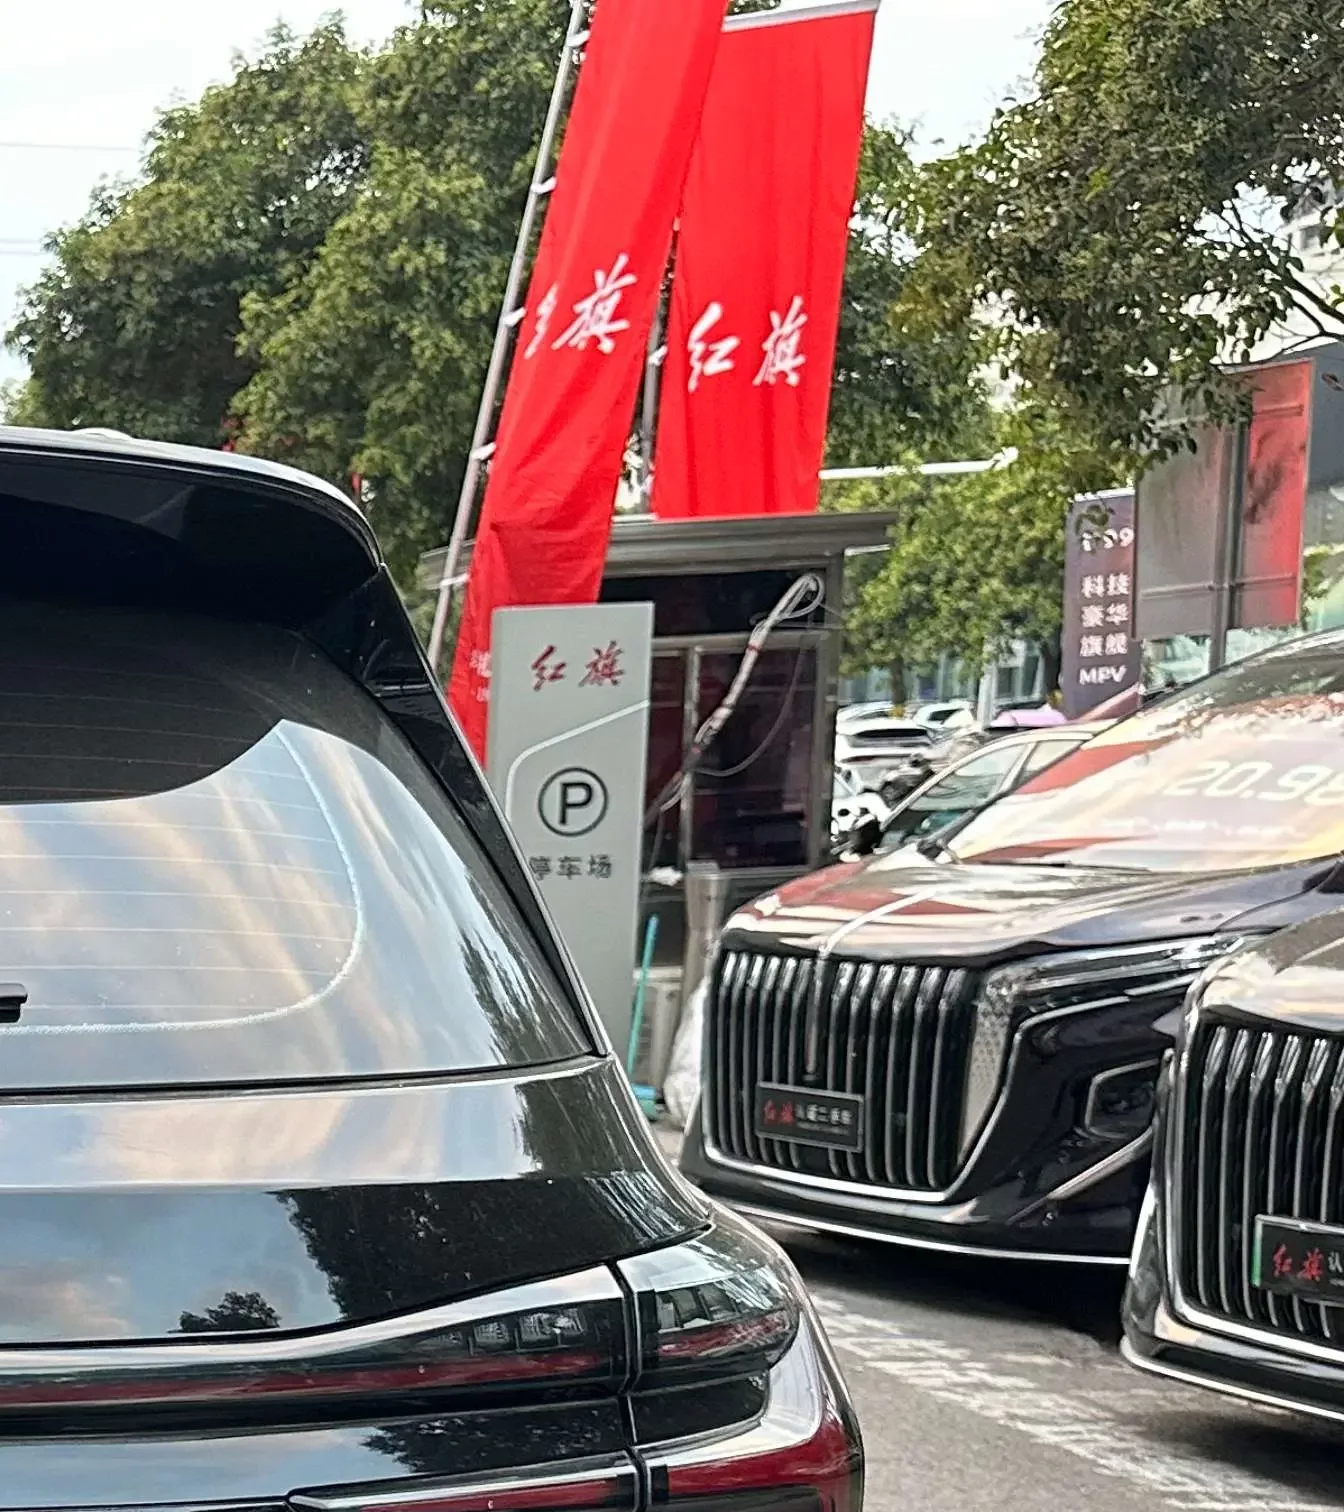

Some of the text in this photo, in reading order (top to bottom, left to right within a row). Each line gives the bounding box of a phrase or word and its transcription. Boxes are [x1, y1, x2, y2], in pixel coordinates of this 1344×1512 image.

[687, 295, 809, 393] 红旗
[531, 640, 626, 691] 红旗
[1079, 665, 1127, 686] MPV
[559, 781, 593, 826] P
[529, 855, 614, 881] 停车场
[1273, 1244, 1325, 1282] 红旗
